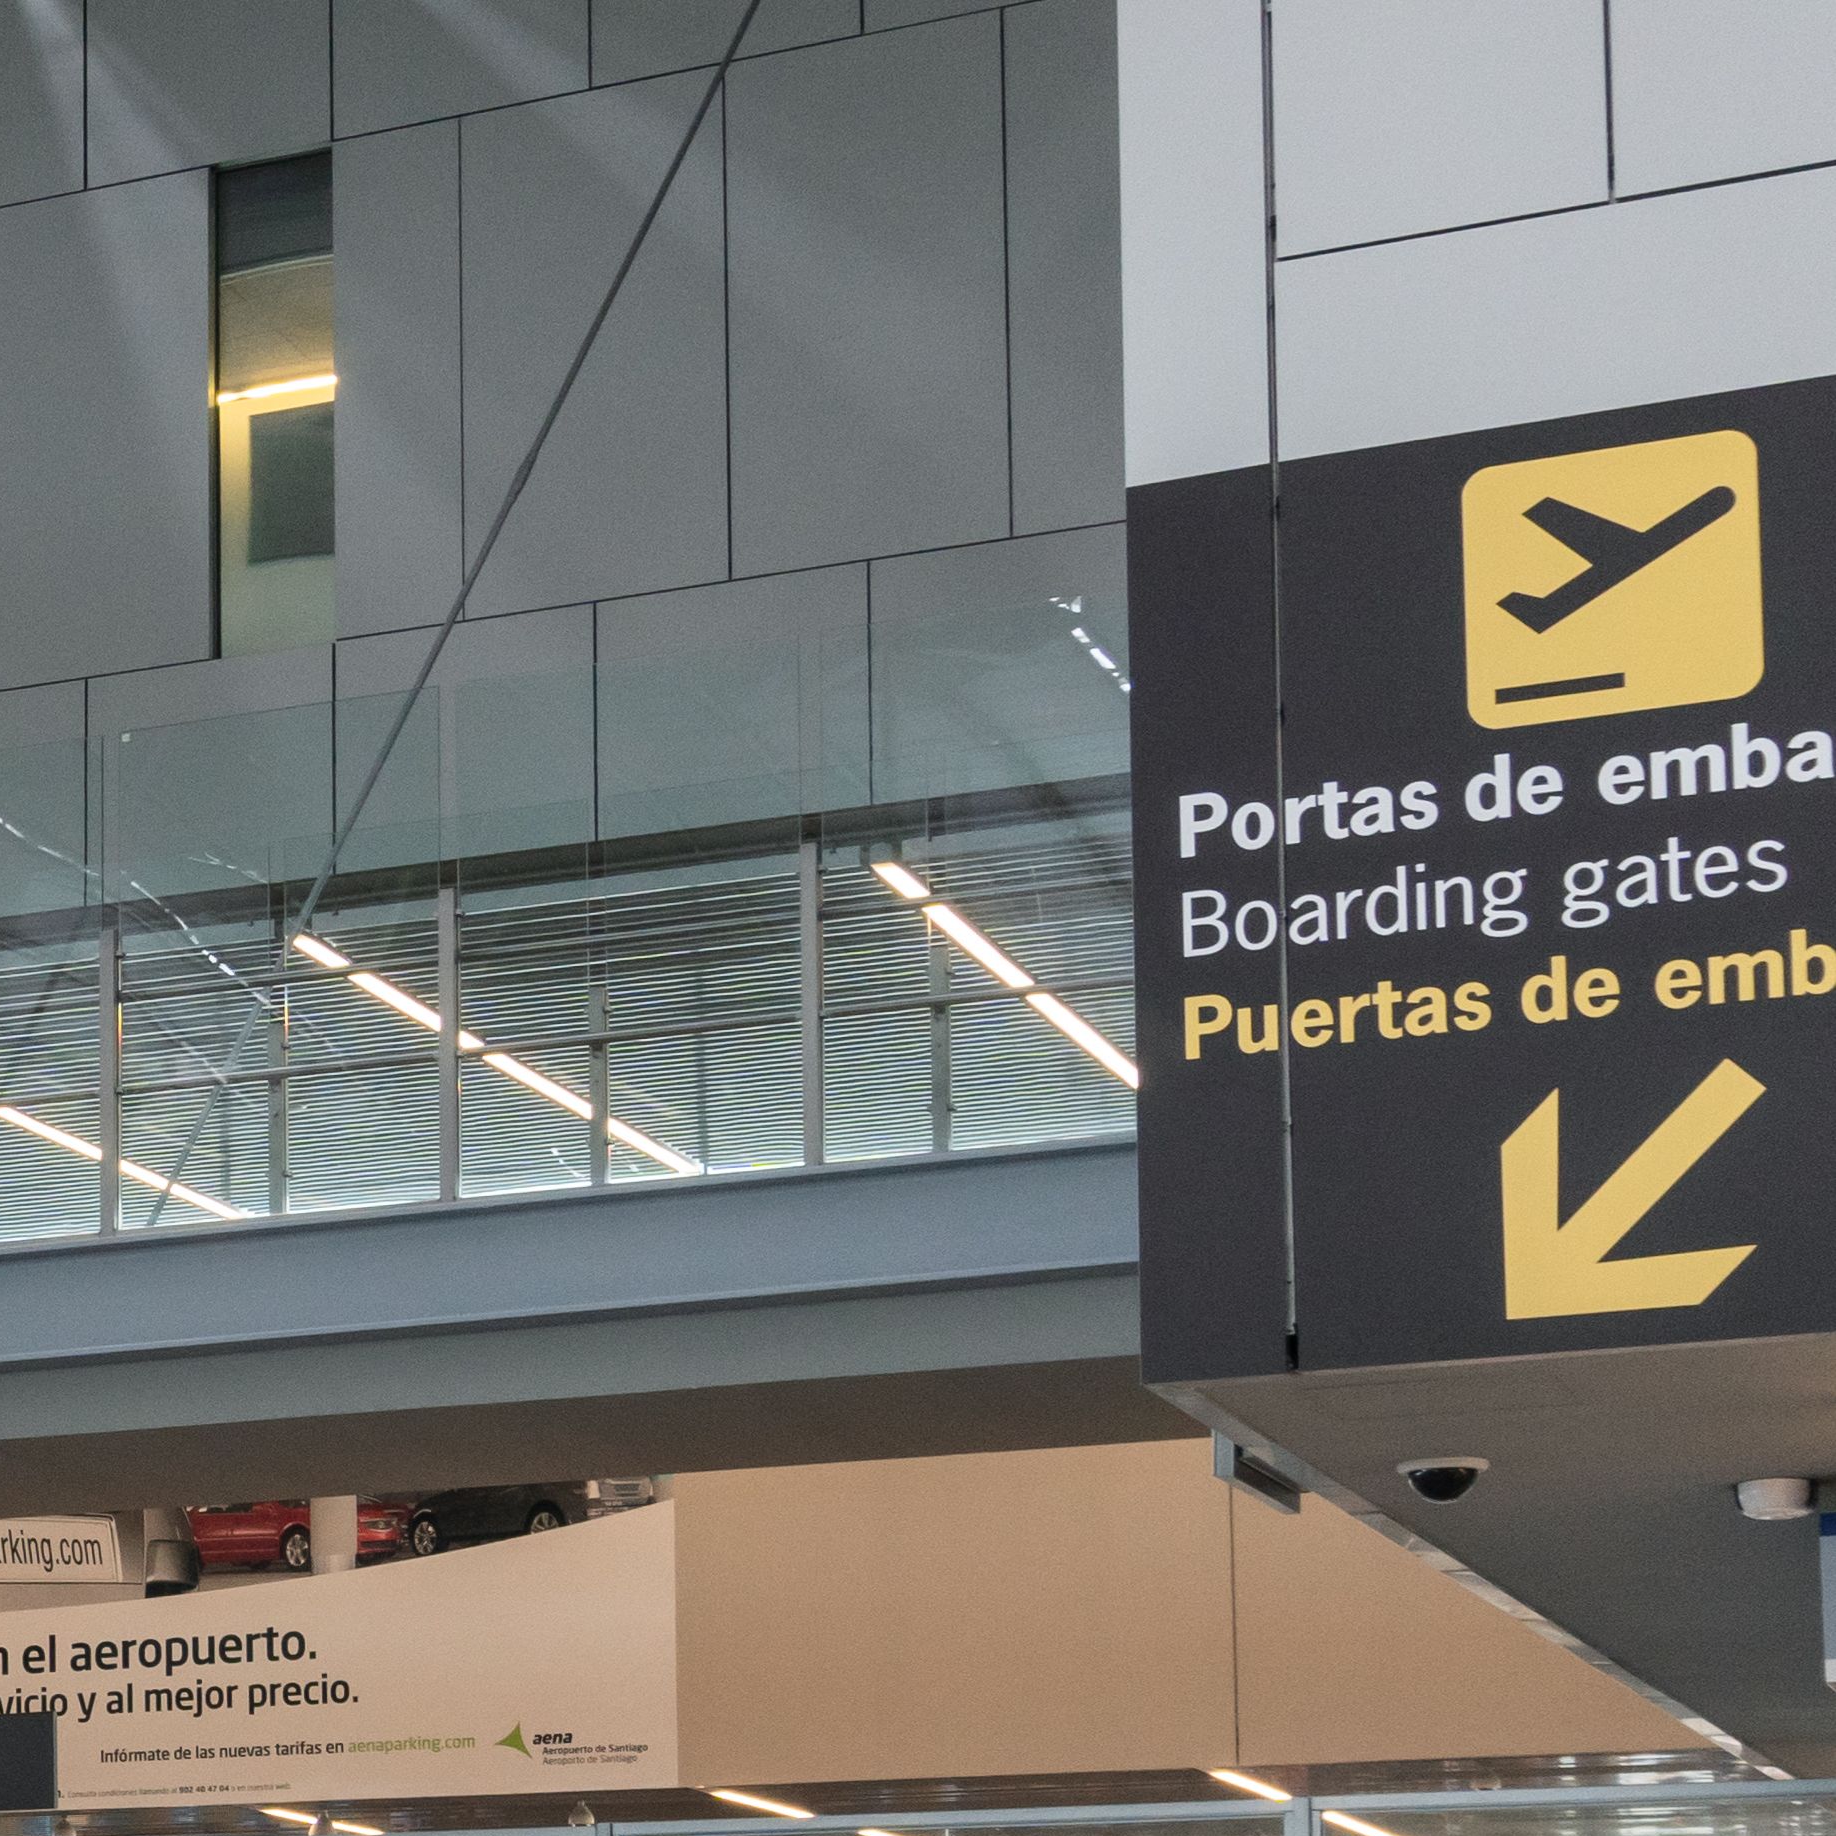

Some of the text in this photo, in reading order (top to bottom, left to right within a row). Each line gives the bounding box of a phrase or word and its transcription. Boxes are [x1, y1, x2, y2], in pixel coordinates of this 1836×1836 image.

[1178, 722, 1835, 858] Portas de emba
[1181, 837, 1789, 958] Boarding gates
[1183, 928, 1836, 1061] Puertas de emb
[22, 1634, 57, 1674] el
[70, 1627, 317, 1677] aeropuerto.
[77, 1691, 97, 1722] y
[106, 1684, 134, 1714] al
[144, 1681, 238, 1718] mejor
[248, 1674, 359, 1709] precio.
[100, 1735, 476, 1763] Infórmate de las nuevas tarifas en aenaparking.com
[532, 1732, 573, 1745] aena
[542, 1743, 648, 1756] Aeropuerto de Santiago
